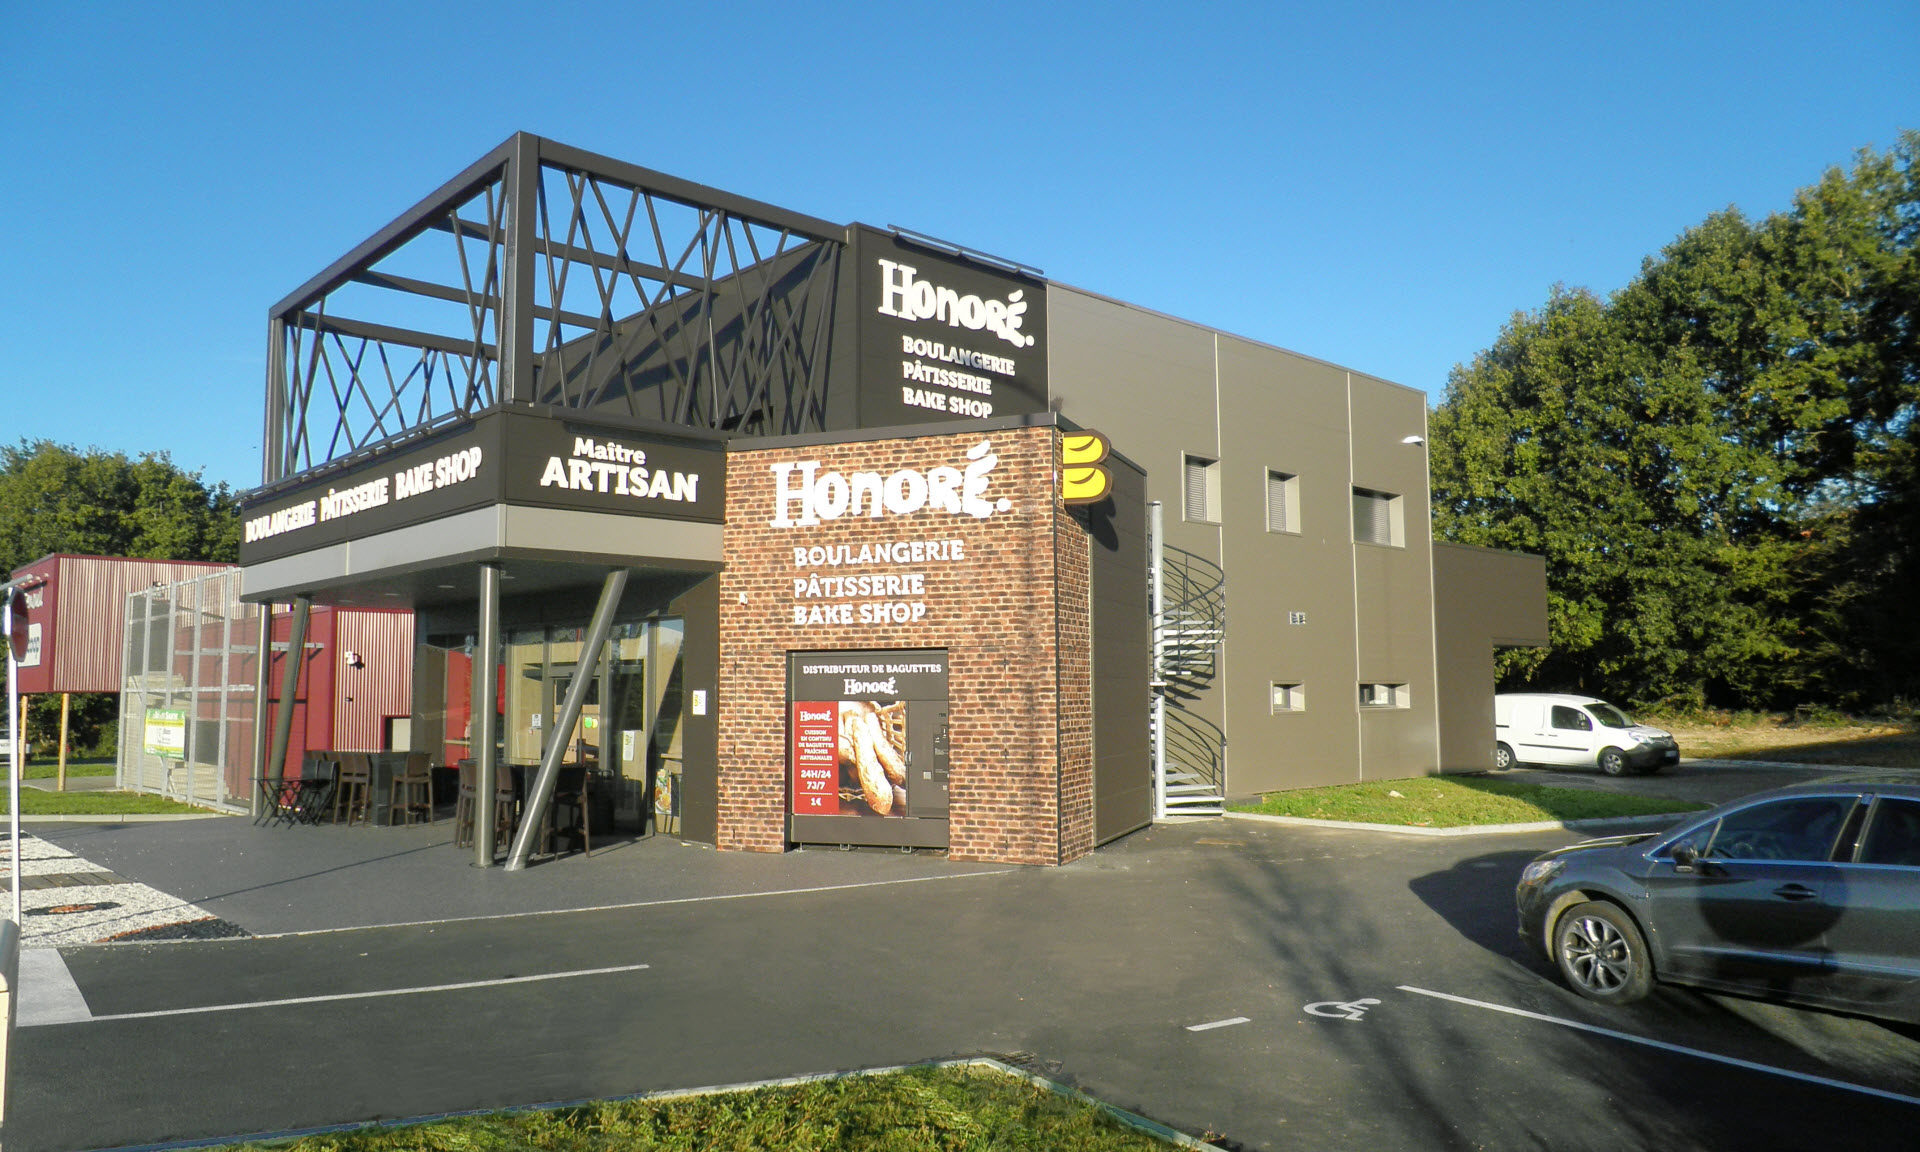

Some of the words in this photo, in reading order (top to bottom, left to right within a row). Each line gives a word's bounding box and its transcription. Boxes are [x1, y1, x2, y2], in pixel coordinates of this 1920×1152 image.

[902, 335, 1016, 377] BOULANGERIE
[902, 360, 992, 395] PÂTISSERIE
[902, 387, 947, 411] BAKE
[949, 396, 993, 419] SHOP
[573, 437, 646, 465] Maître
[540, 456, 699, 503] ARTISAN
[245, 500, 317, 543] BOULANGERIE
[320, 477, 389, 522] PÂTISSERIE
[395, 462, 434, 501] BAKE
[434, 446, 482, 489] SHOP
[793, 539, 965, 567] BOULANGERIE
[793, 573, 925, 598] PÂTISSERIE
[793, 605, 854, 625] BAKE
[859, 603, 926, 624] SHOP
[802, 665, 870, 675] DISTRIBUTEUR
[872, 664, 885, 674] DE
[886, 664, 942, 674] BAGUETTES
[800, 769, 832, 779] 24H/24
[806, 781, 826, 790] 7J/7
